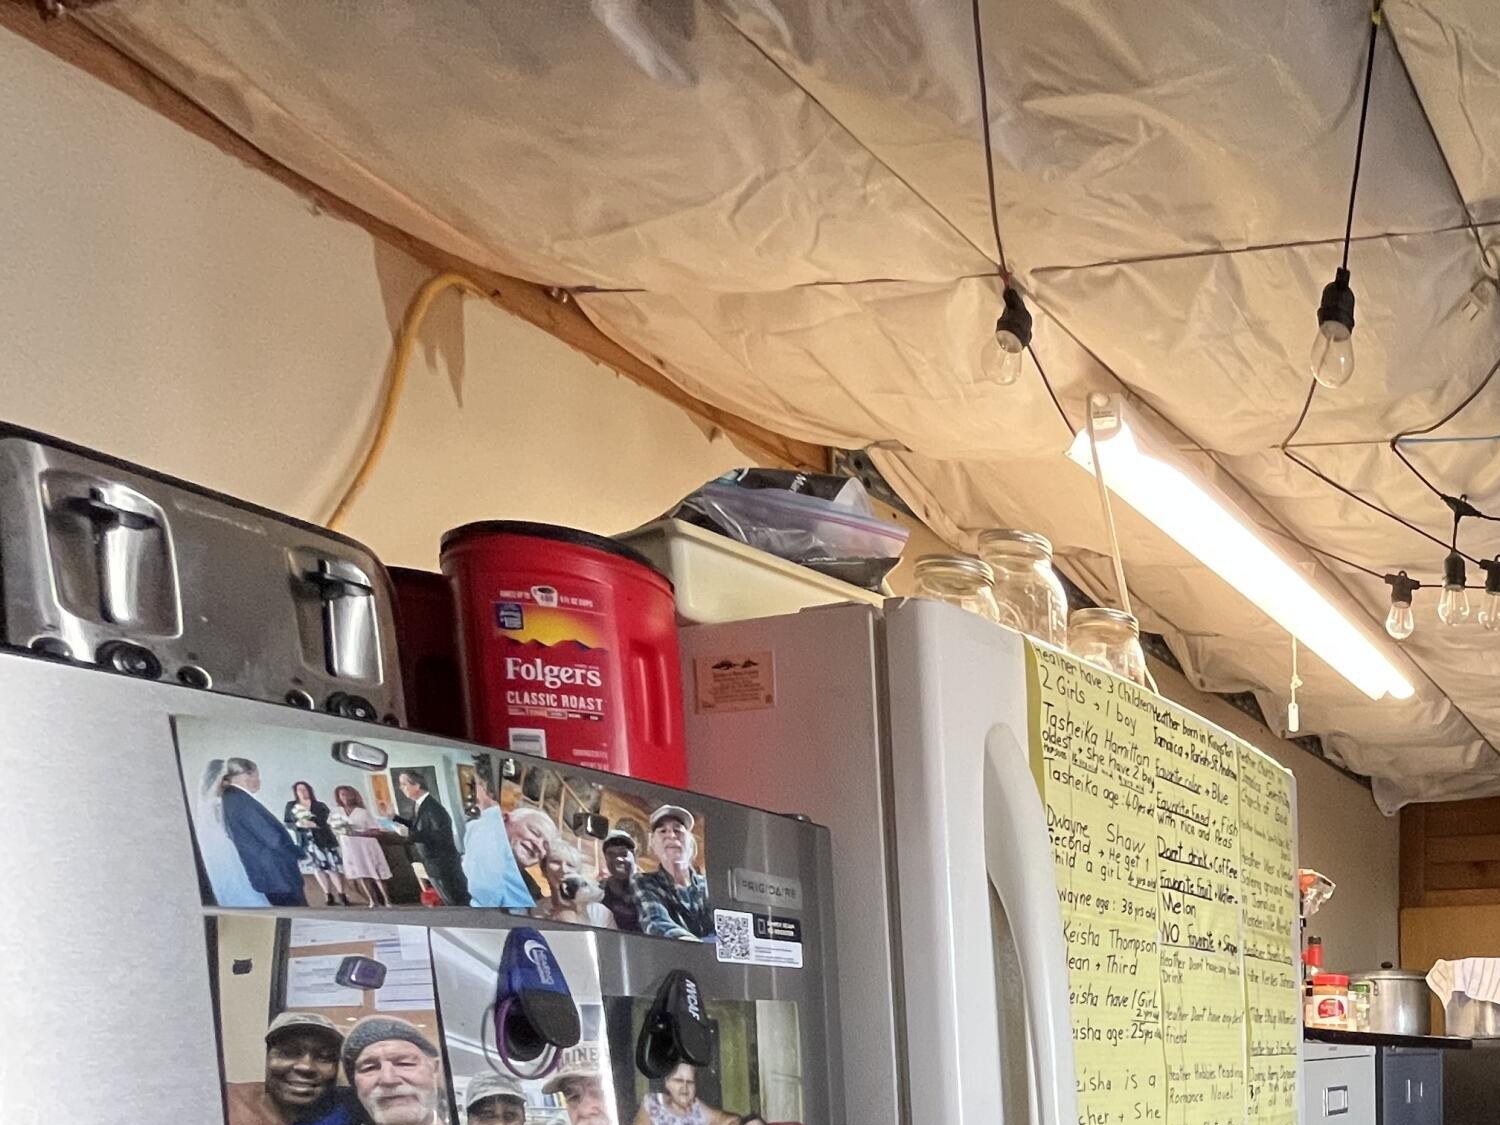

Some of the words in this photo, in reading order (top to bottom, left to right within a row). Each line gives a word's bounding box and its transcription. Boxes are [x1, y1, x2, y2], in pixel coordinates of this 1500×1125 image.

[504, 656, 602, 690] Folgers
[1080, 662, 1102, 690] have
[1106, 674, 1114, 695] 3
[1117, 681, 1154, 713] Children
[506, 690, 558, 708] CLASSIC
[560, 694, 603, 712] ROAST
[1040, 664, 1054, 691] 2
[1056, 675, 1086, 705] Girls
[1116, 702, 1137, 737] boy
[1104, 728, 1150, 768] Hamilton
[1153, 725, 1184, 758] Jamaica
[1211, 781, 1229, 806] Blue
[1046, 803, 1090, 839] Dwayne
[1106, 822, 1146, 854] Shaw
[1220, 815, 1239, 838] Fish
[1053, 847, 1077, 869] hild
[741, 879, 798, 900] FRIGIDAIRE
[1056, 886, 1092, 911] wayne
[1161, 891, 1197, 918] Melon
[1062, 920, 1101, 948] Keisha
[1108, 928, 1158, 958] Thompson
[1162, 920, 1180, 944] NO
[1106, 953, 1139, 976] Third
[1069, 982, 1099, 1008] eisha
[1105, 985, 1129, 1008] have
[1169, 1086, 1204, 1104] Romance
[1078, 1104, 1110, 1125] cher
[1134, 1102, 1161, 1120] She
